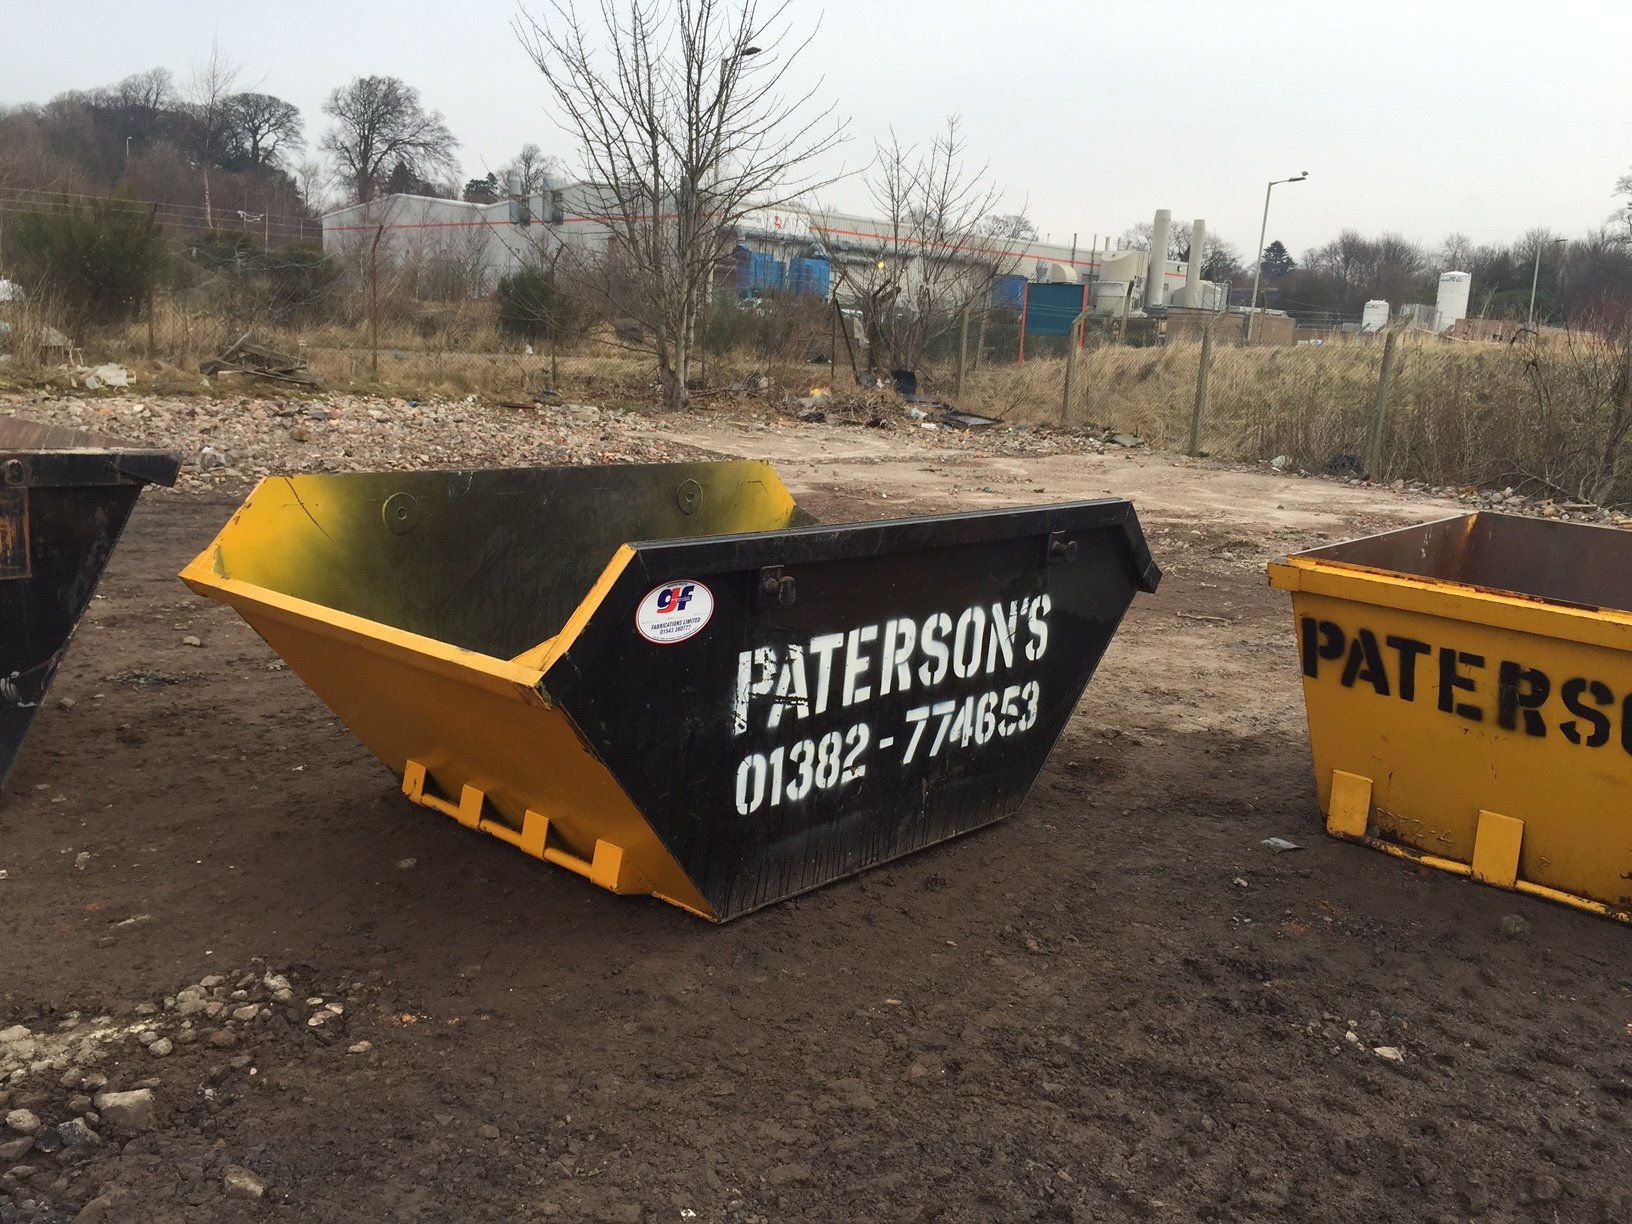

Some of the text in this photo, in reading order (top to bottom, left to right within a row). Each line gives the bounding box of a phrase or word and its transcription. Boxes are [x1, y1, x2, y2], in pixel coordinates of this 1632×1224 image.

[651, 617, 701, 630] FABRICATIONS LIMITED
[733, 593, 1052, 736] PATERSON'S
